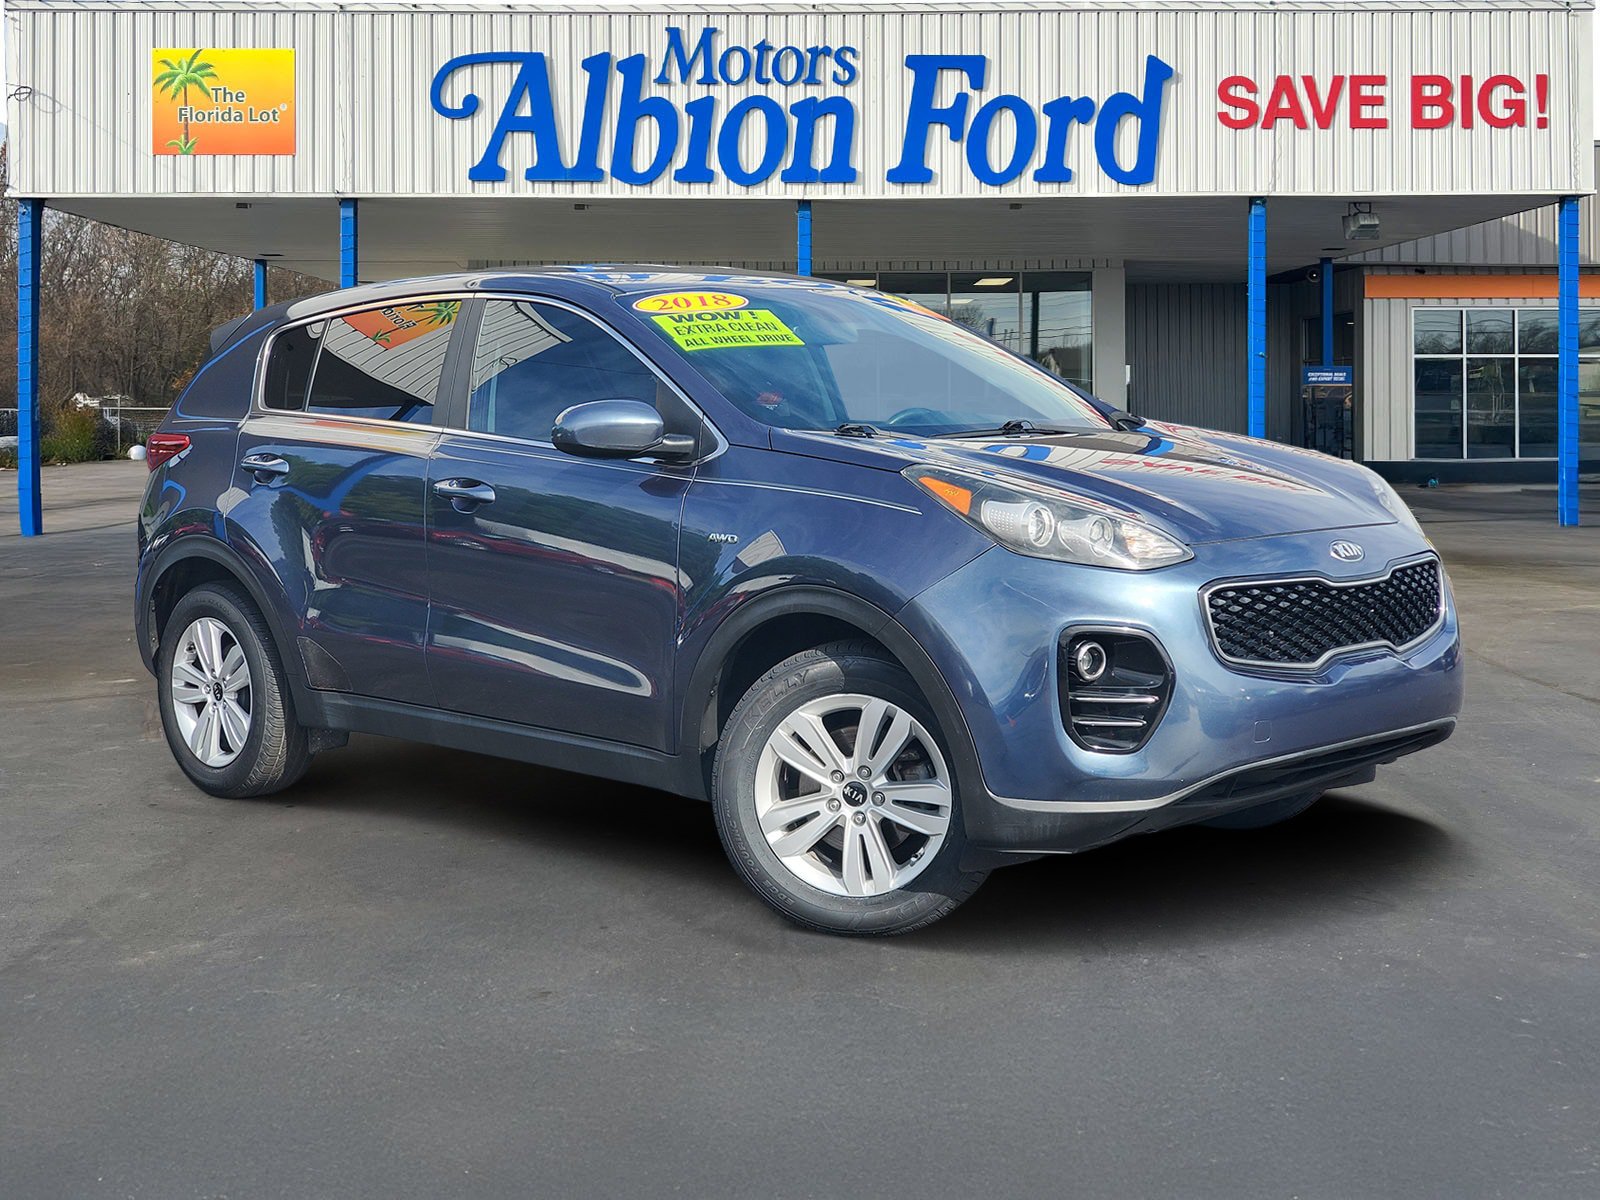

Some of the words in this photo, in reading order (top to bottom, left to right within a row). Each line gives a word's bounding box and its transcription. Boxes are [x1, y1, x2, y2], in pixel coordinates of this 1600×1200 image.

[655, 27, 856, 86] Motors
[211, 87, 246, 103] The
[1217, 74, 1388, 129] SAVE
[1410, 74, 1548, 129] BIG!
[178, 107, 243, 122] Florida
[431, 52, 857, 186] Albion
[887, 55, 1174, 186] Ford
[652, 294, 732, 311] 2018
[673, 322, 728, 336] EXTRA
[728, 321, 779, 332] CLEAN
[685, 336, 708, 347] ALL
[709, 334, 753, 345] WHEEL
[755, 333, 794, 343] DRIVE
[707, 532, 738, 544] AWD
[1332, 543, 1362, 558] KIA
[743, 669, 809, 730] KELLY
[843, 785, 864, 804] KIA
